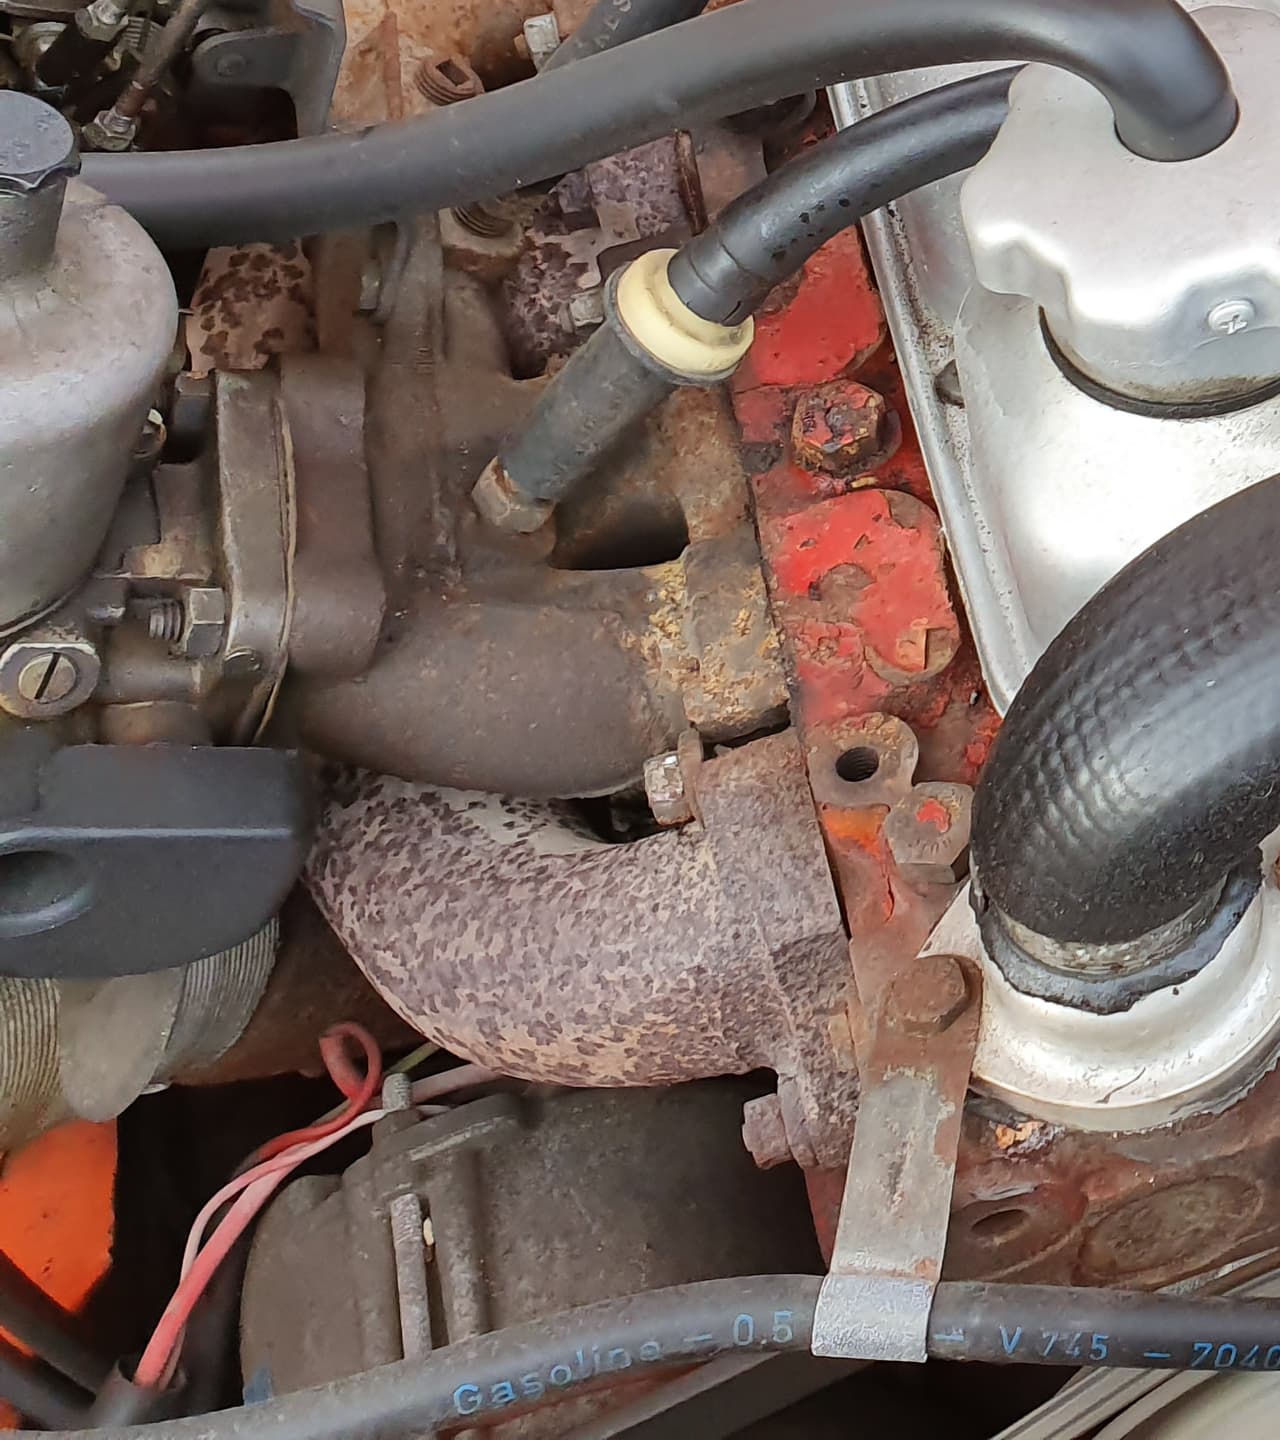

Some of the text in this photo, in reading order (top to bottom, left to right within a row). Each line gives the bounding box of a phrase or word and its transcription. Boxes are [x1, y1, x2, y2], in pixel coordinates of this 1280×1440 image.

[452, 1339, 663, 1417] Gasoline
[732, 1309, 795, 1348] 0.5
[999, 1325, 1023, 1355] V
